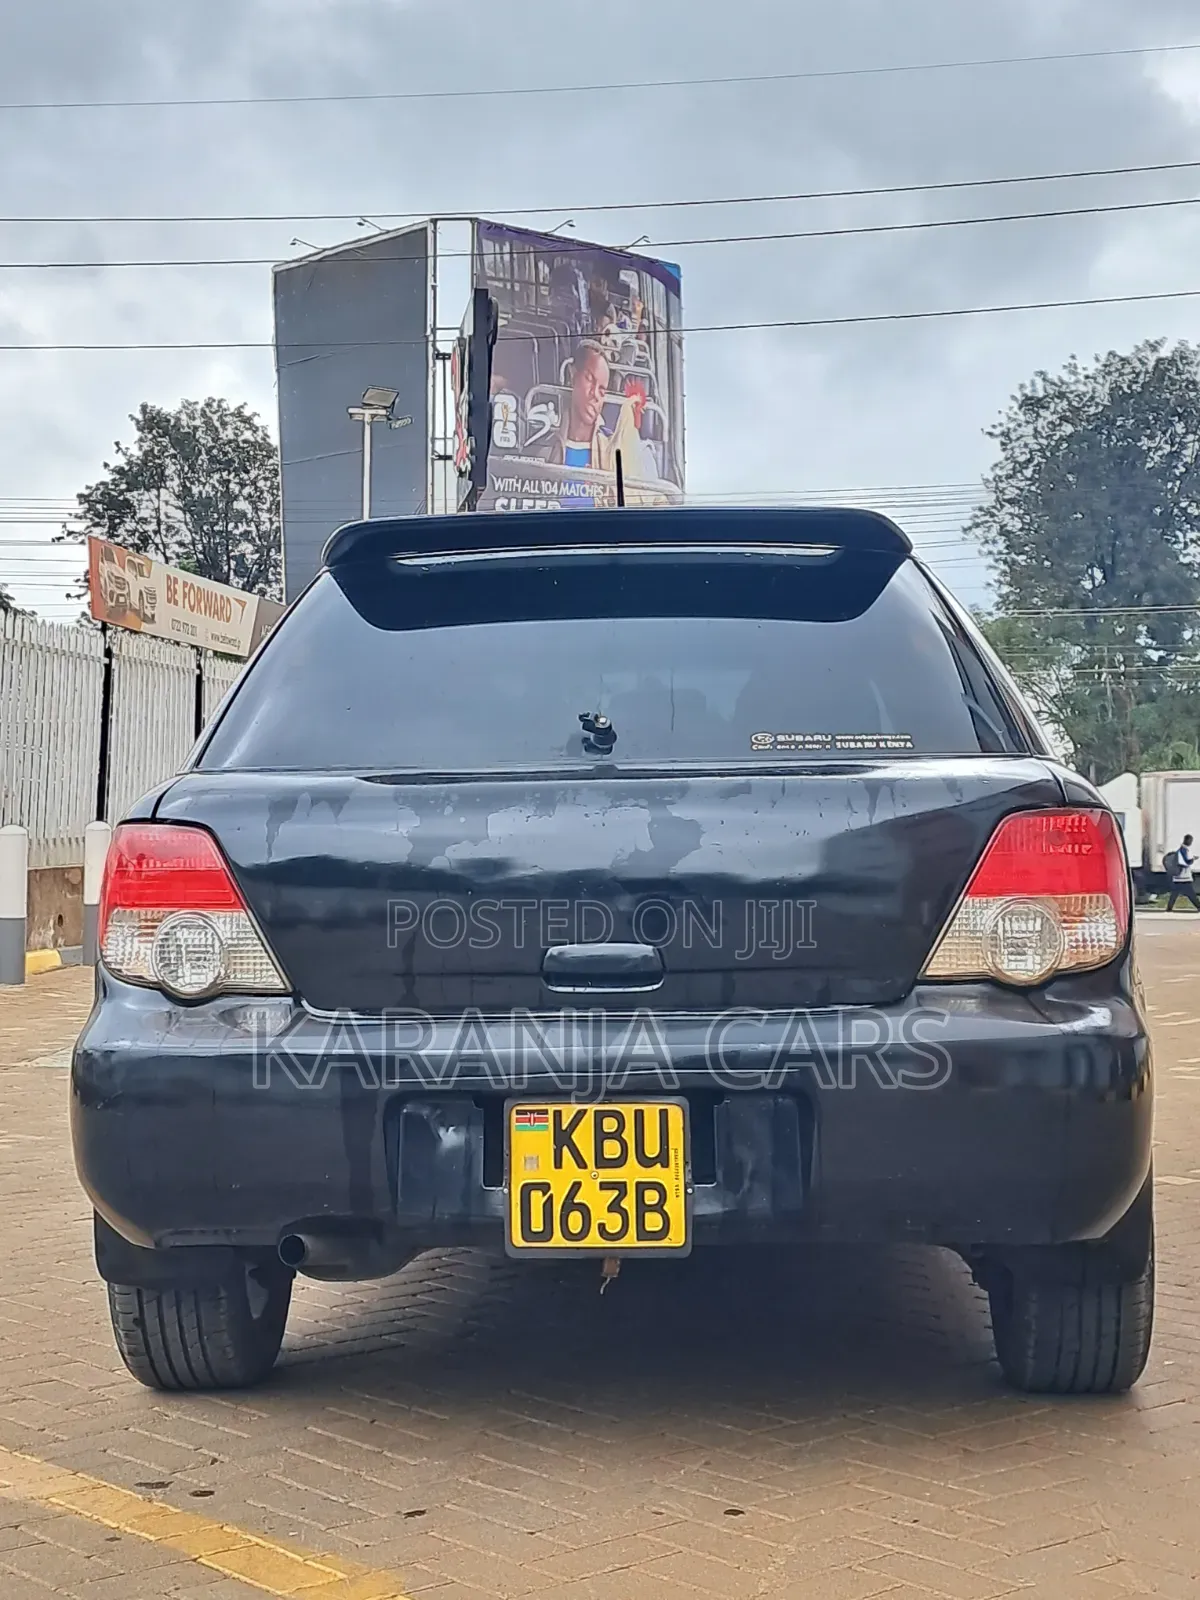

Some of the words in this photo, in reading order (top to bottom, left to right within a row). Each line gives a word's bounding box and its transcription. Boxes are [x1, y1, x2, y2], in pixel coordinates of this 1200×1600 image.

[491, 474, 521, 492] WITH
[523, 479, 539, 494] ALL
[541, 480, 558, 495] 104
[166, 574, 179, 607] BE
[182, 580, 232, 623] FORWARD
[776, 734, 832, 742] SUBARU
[552, 1107, 670, 1170] KBU
[520, 1180, 671, 1243] 063B
